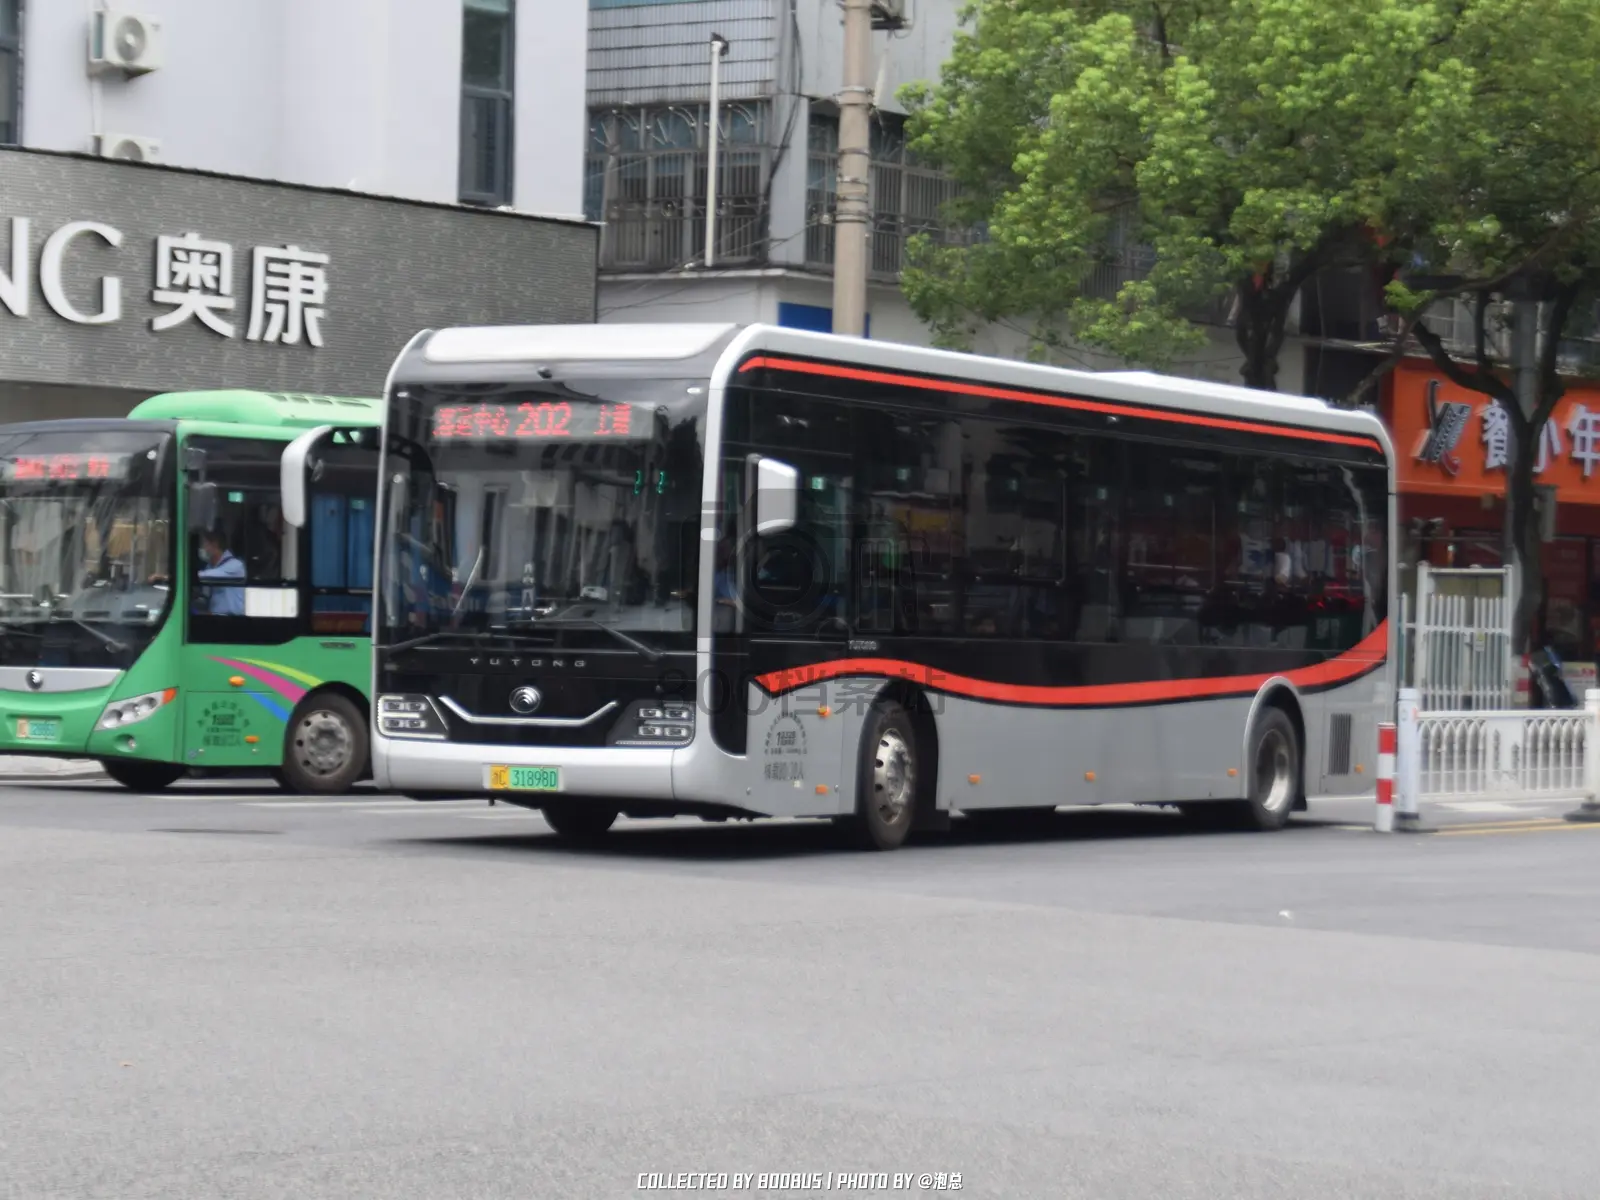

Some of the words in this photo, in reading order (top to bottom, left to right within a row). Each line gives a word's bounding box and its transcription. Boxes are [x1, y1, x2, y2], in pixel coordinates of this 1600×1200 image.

[152, 232, 330, 347] 奥康
[515, 401, 571, 436] 202
[470, 657, 585, 668] YUTONG
